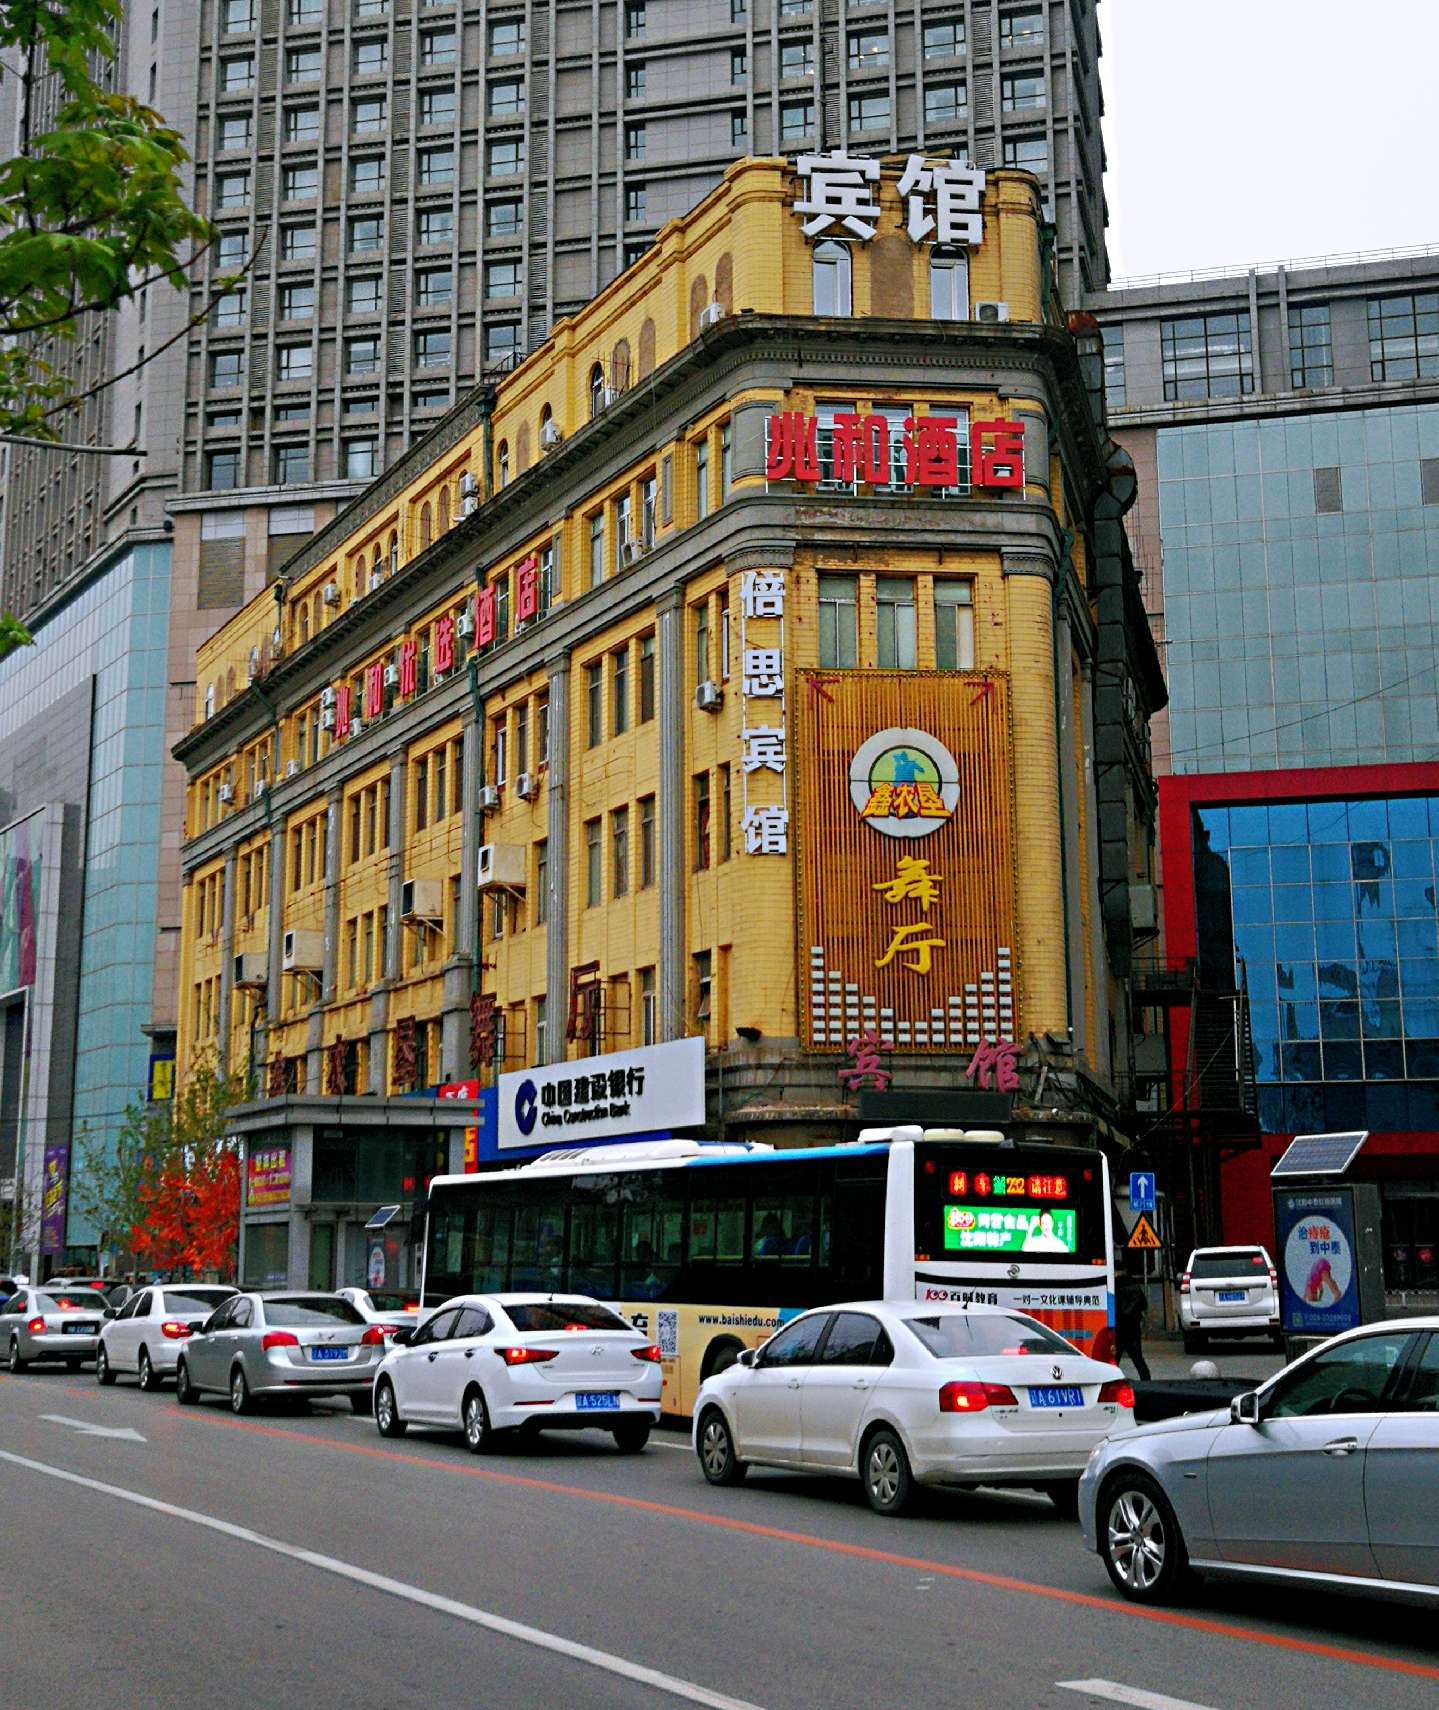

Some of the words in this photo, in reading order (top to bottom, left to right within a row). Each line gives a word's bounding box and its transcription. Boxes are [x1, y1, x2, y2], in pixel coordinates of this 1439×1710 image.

[793, 150, 987, 246] 宾馆
[766, 411, 1026, 488] 兆和酒店
[740, 571, 790, 855] 倍思宾馆
[861, 782, 954, 821] 鑫农垦
[871, 855, 946, 976] 舞厅
[541, 1066, 646, 1108] 中国建设银行
[838, 1030, 1022, 1093] 宾馆
[541, 1110, 563, 1127] China
[609, 1100, 631, 1118] Bank
[698, 1312, 785, 1329] www.baishiedu.com
